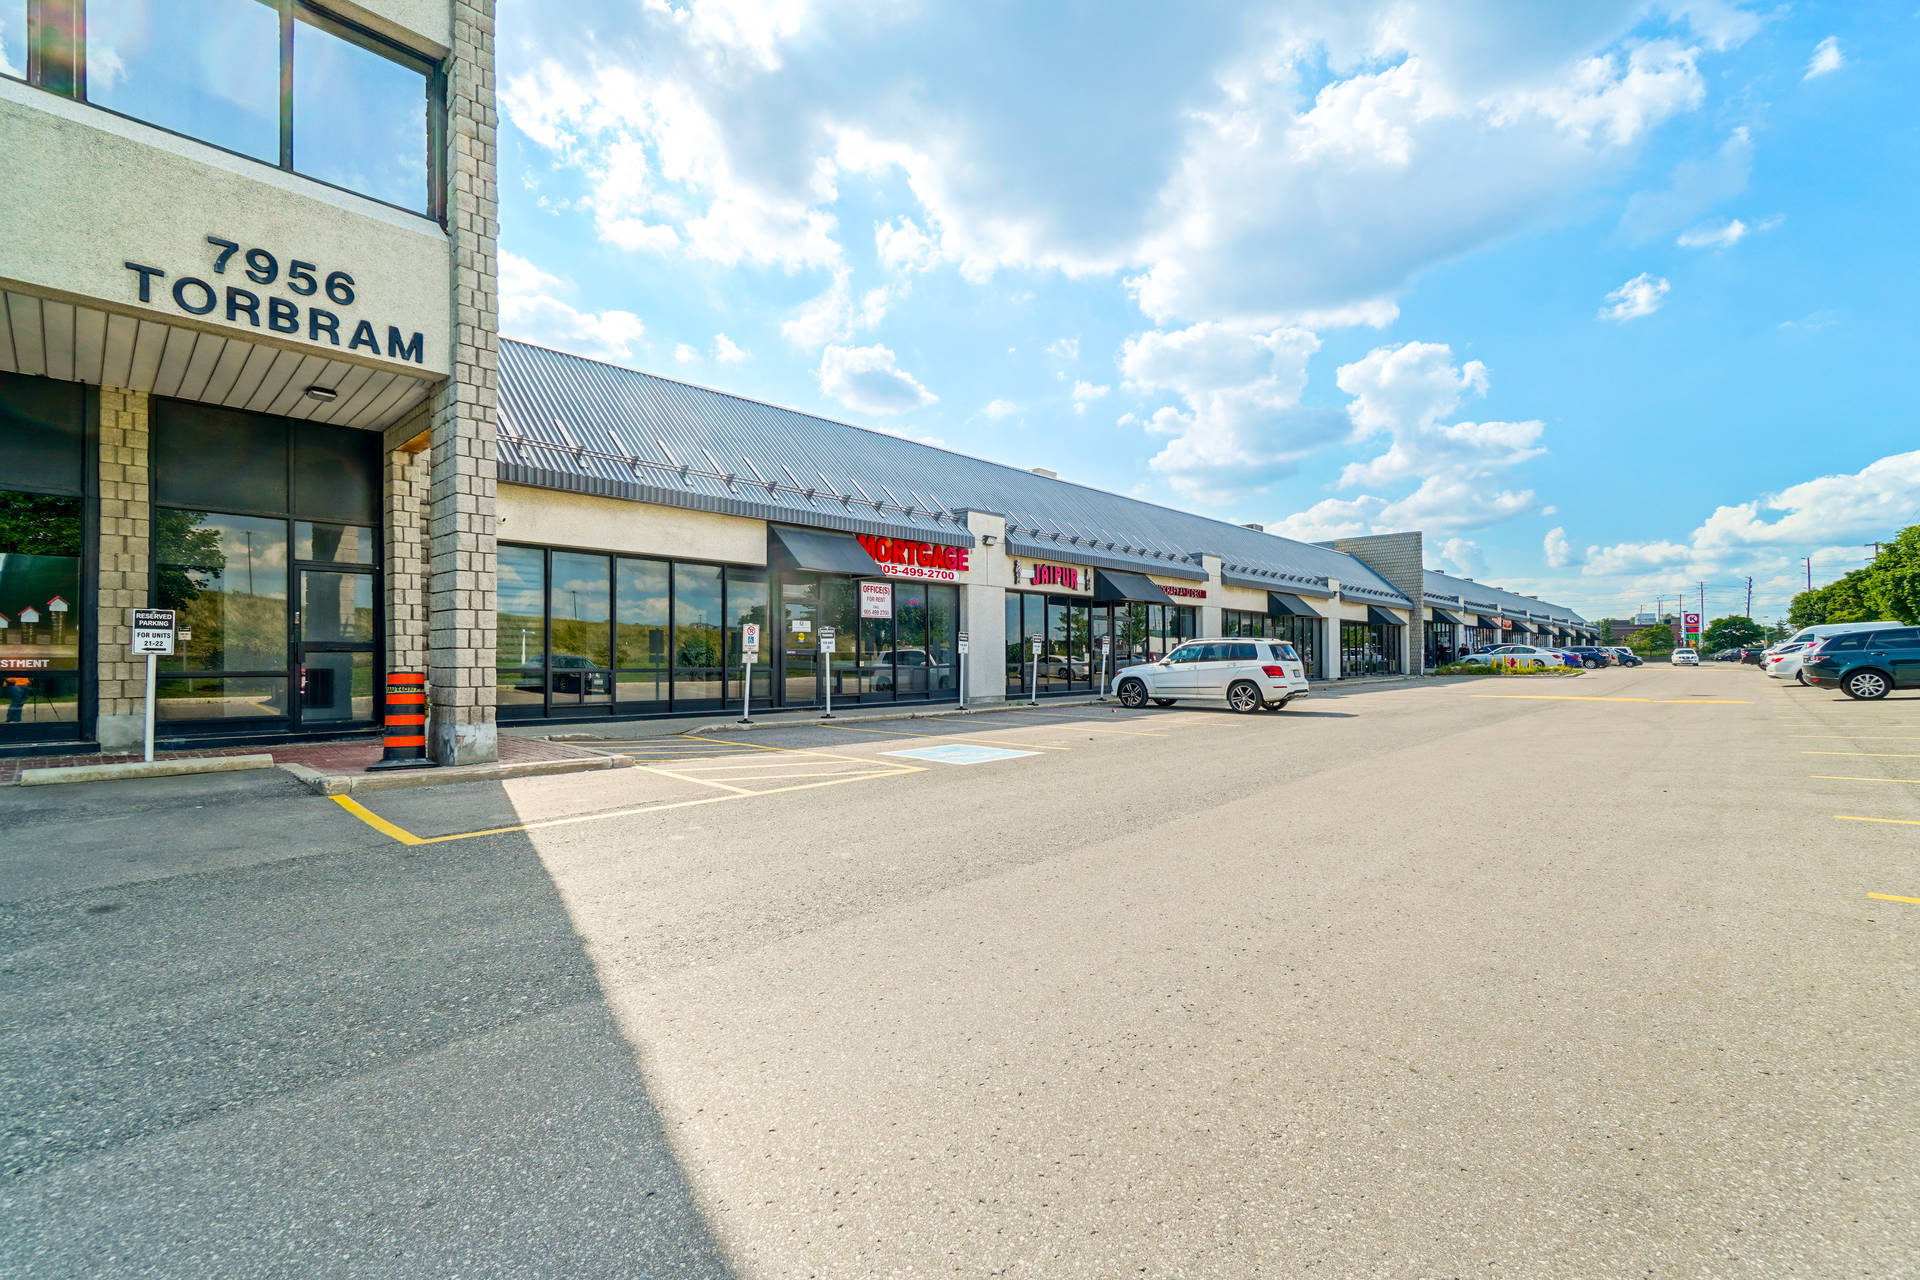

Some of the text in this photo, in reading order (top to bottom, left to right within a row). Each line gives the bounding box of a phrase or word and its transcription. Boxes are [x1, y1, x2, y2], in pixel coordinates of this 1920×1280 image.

[207, 236, 355, 306] 7956
[125, 261, 423, 364] TORBRAM
[856, 534, 969, 572] MORTGAGE
[862, 584, 891, 596] OFFICE(S)
[1031, 563, 1078, 591] JAIPUR
[0, 659, 50, 668] STMENT
